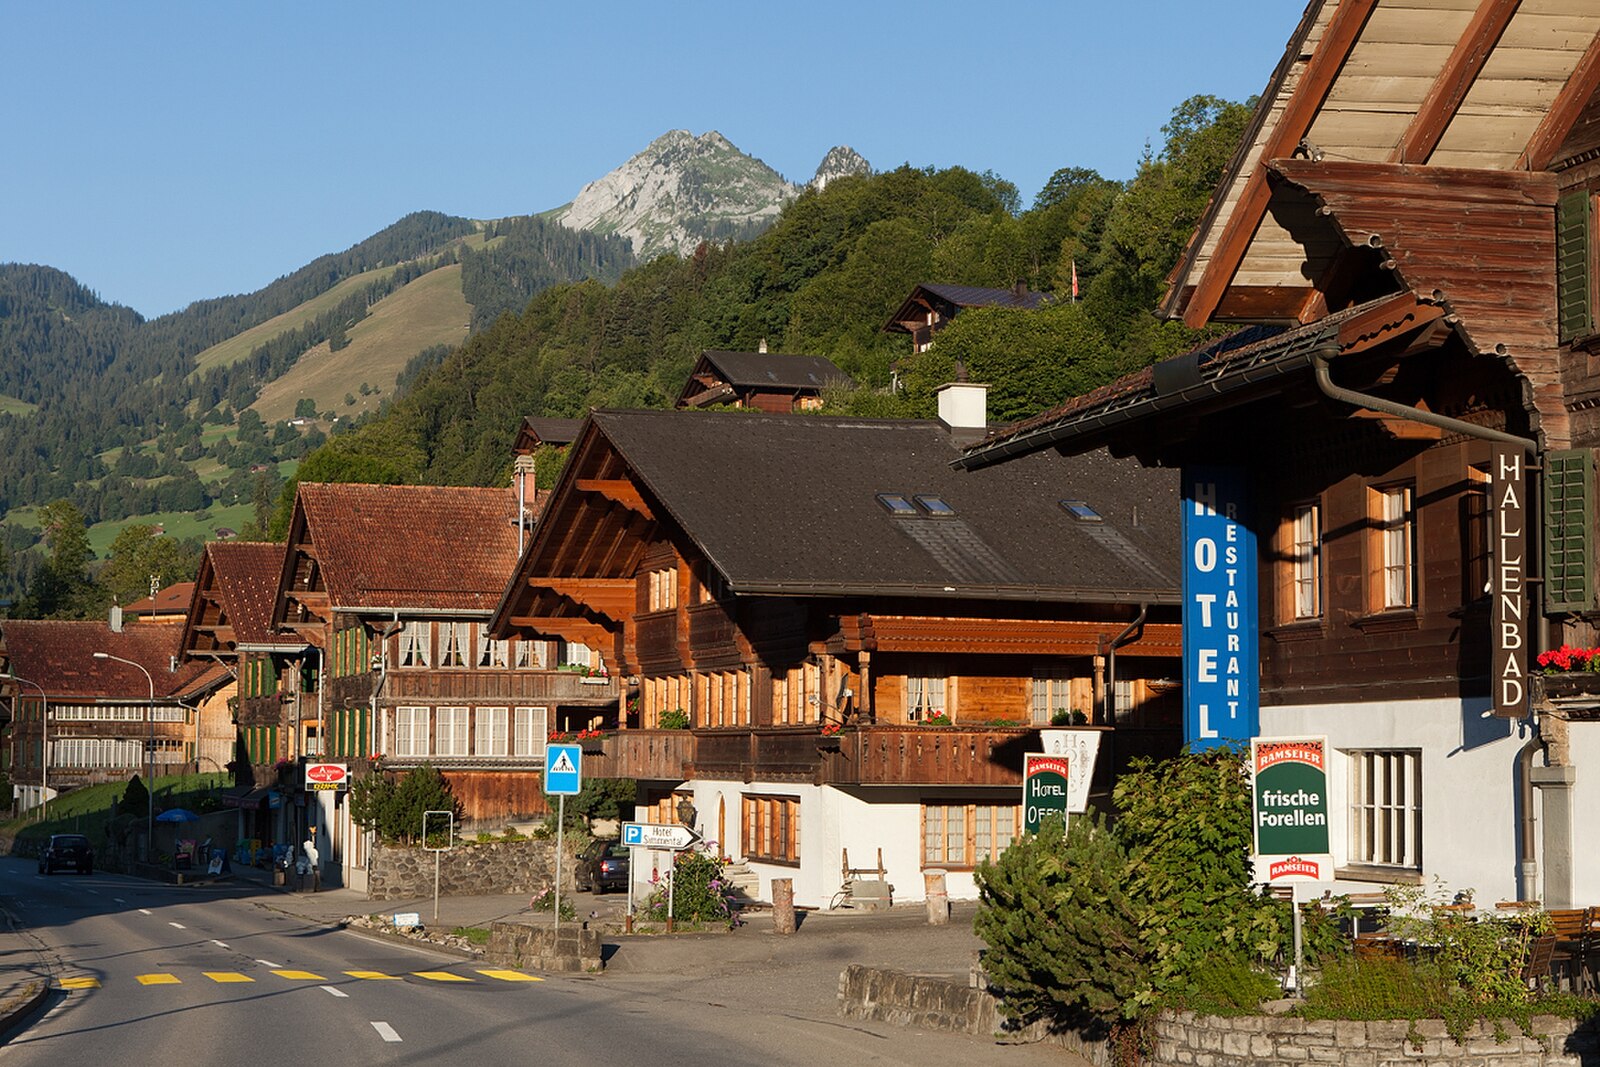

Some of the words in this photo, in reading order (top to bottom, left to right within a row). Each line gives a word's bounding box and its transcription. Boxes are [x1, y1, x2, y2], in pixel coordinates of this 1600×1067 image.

[1499, 454, 1523, 706] HALLENBAD
[1194, 482, 1219, 738] HOTEL
[1225, 502, 1240, 719] RESTAURANT
[1260, 748, 1320, 767] RAMSEIER
[1029, 762, 1066, 775] RAMSEIER
[1262, 789, 1320, 807] frische
[1259, 809, 1326, 827] Forellen
[627, 827, 639, 842] P
[652, 827, 672, 837] Hotel
[1271, 863, 1317, 876] RAMSEIER
